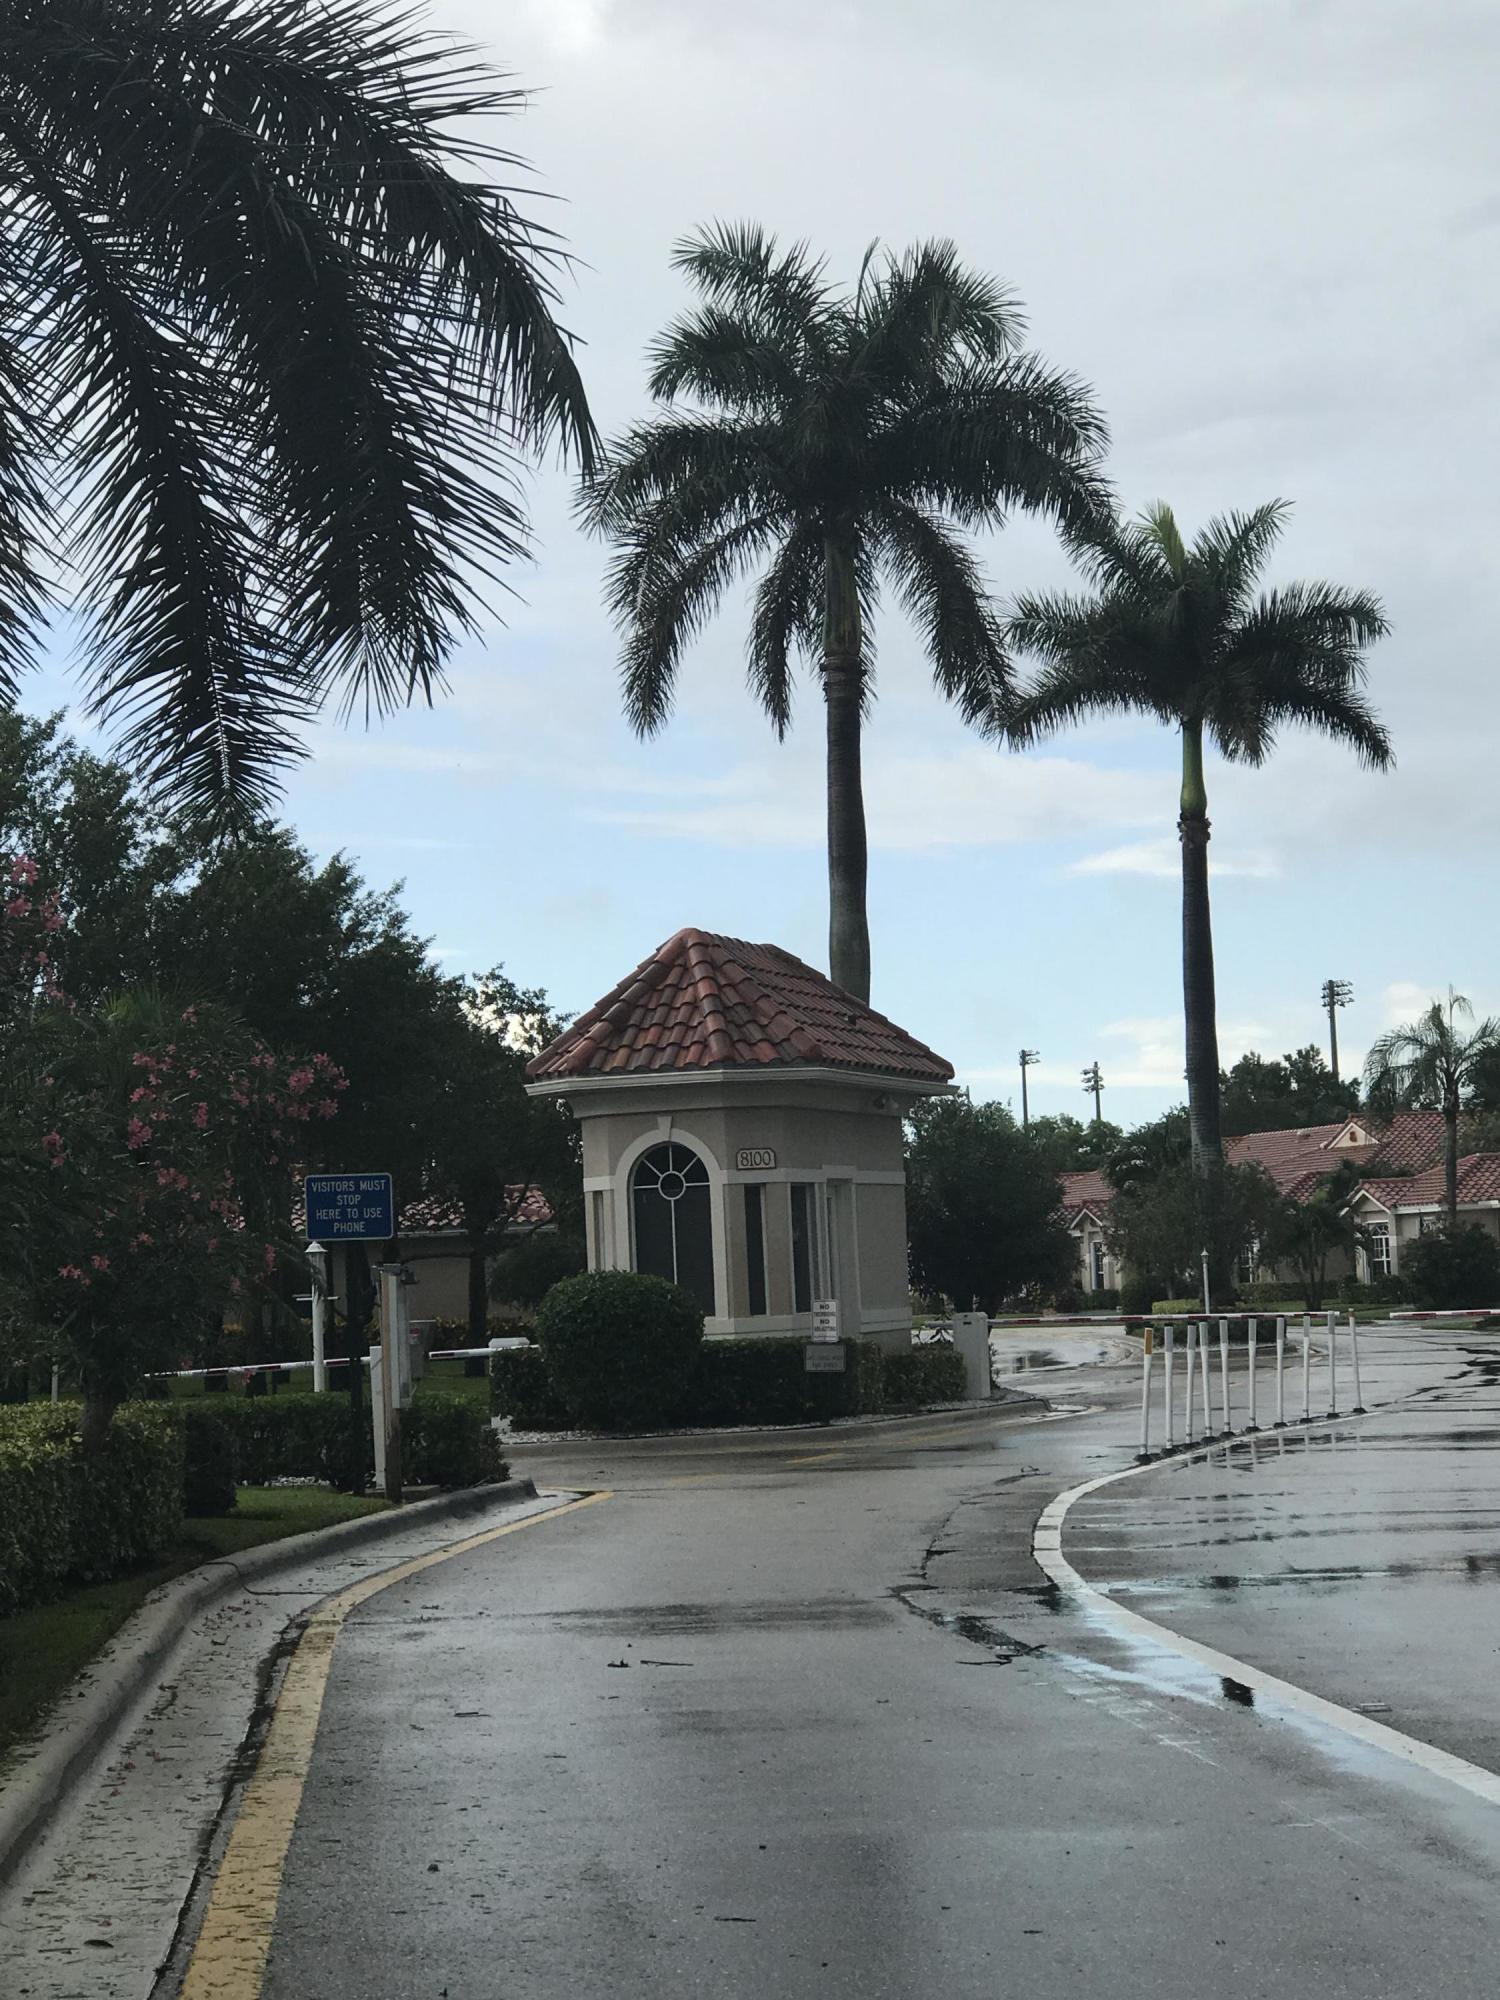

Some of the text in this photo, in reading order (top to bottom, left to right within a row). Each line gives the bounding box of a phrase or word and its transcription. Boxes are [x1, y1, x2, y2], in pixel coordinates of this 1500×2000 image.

[740, 1150, 771, 1167] 8100
[311, 1180, 386, 1193] VISITORS MUST
[336, 1194, 361, 1206] STOP
[316, 1207, 383, 1220] HERE TO USE
[333, 1221, 366, 1233] PHONE
